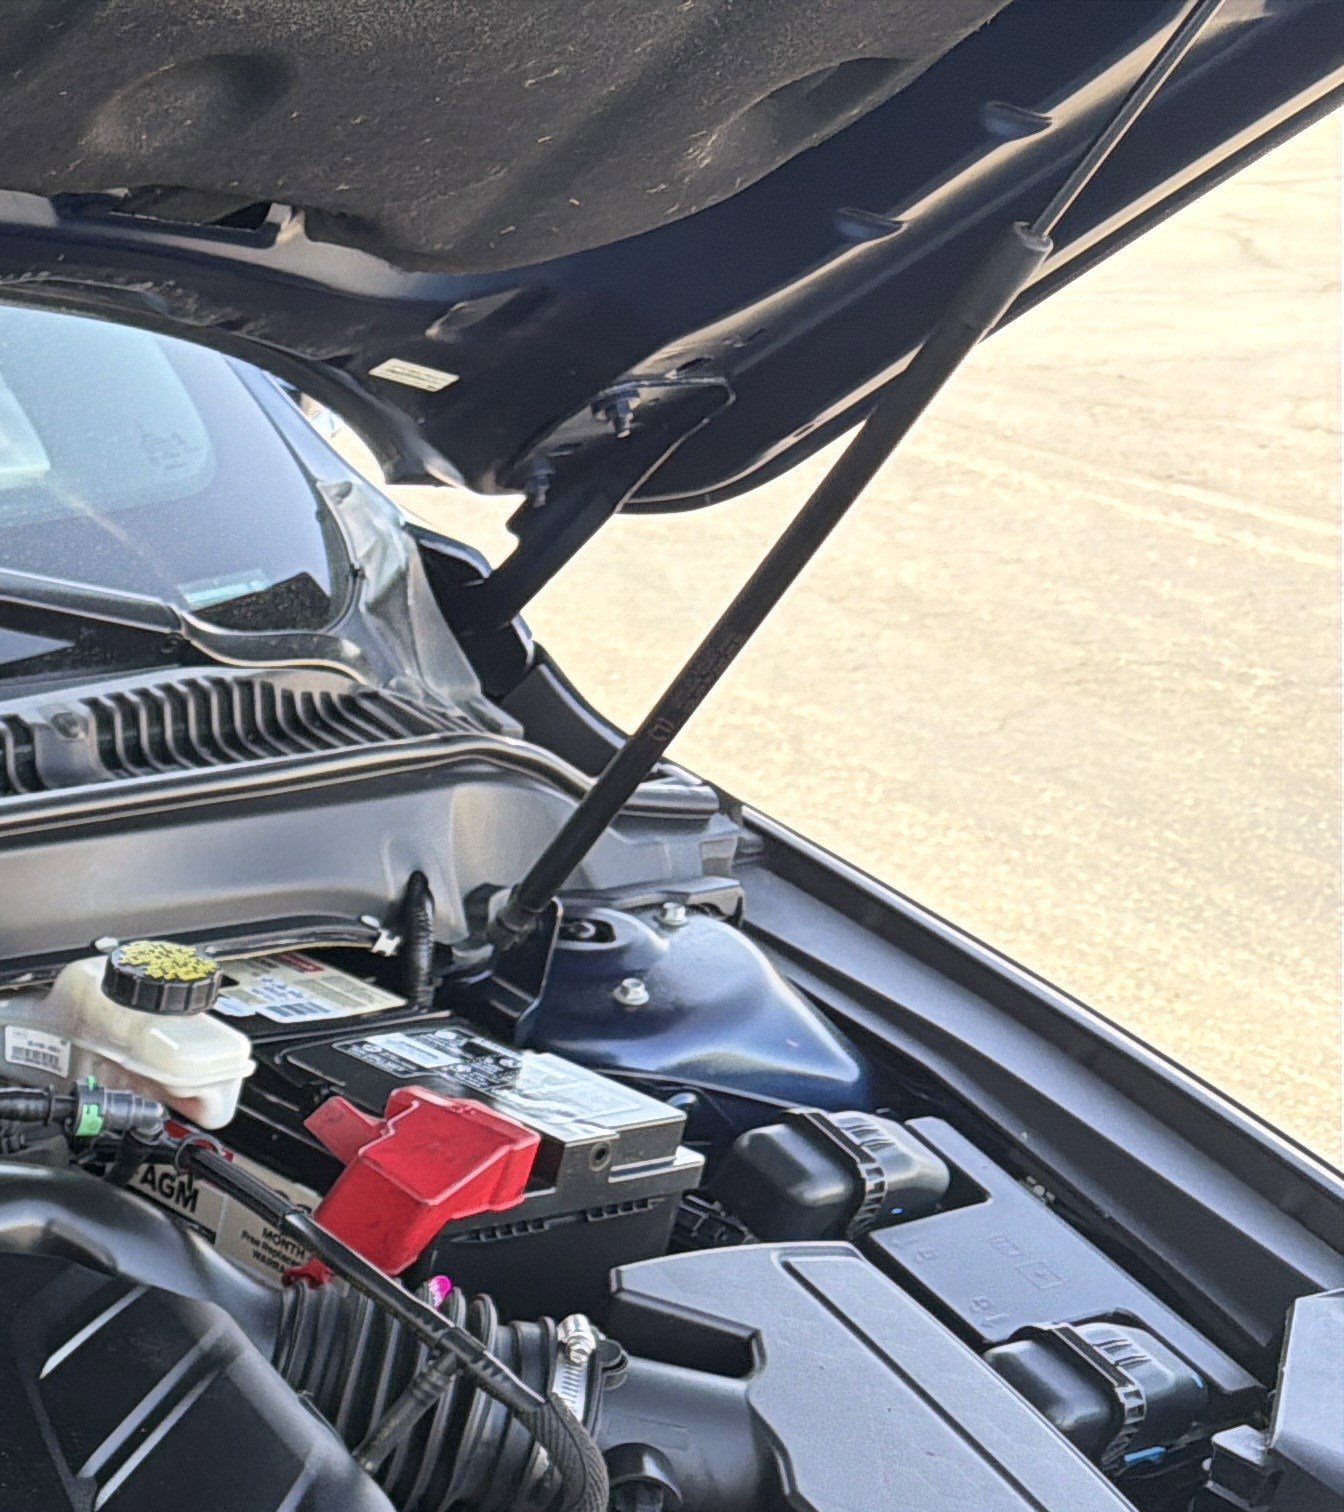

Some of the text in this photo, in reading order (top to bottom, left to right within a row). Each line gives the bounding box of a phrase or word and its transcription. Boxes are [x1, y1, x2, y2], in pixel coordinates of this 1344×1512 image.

[139, 1165, 199, 1213] AGM
[262, 1227, 306, 1260] MONTH
[252, 1249, 285, 1274] WARRA
